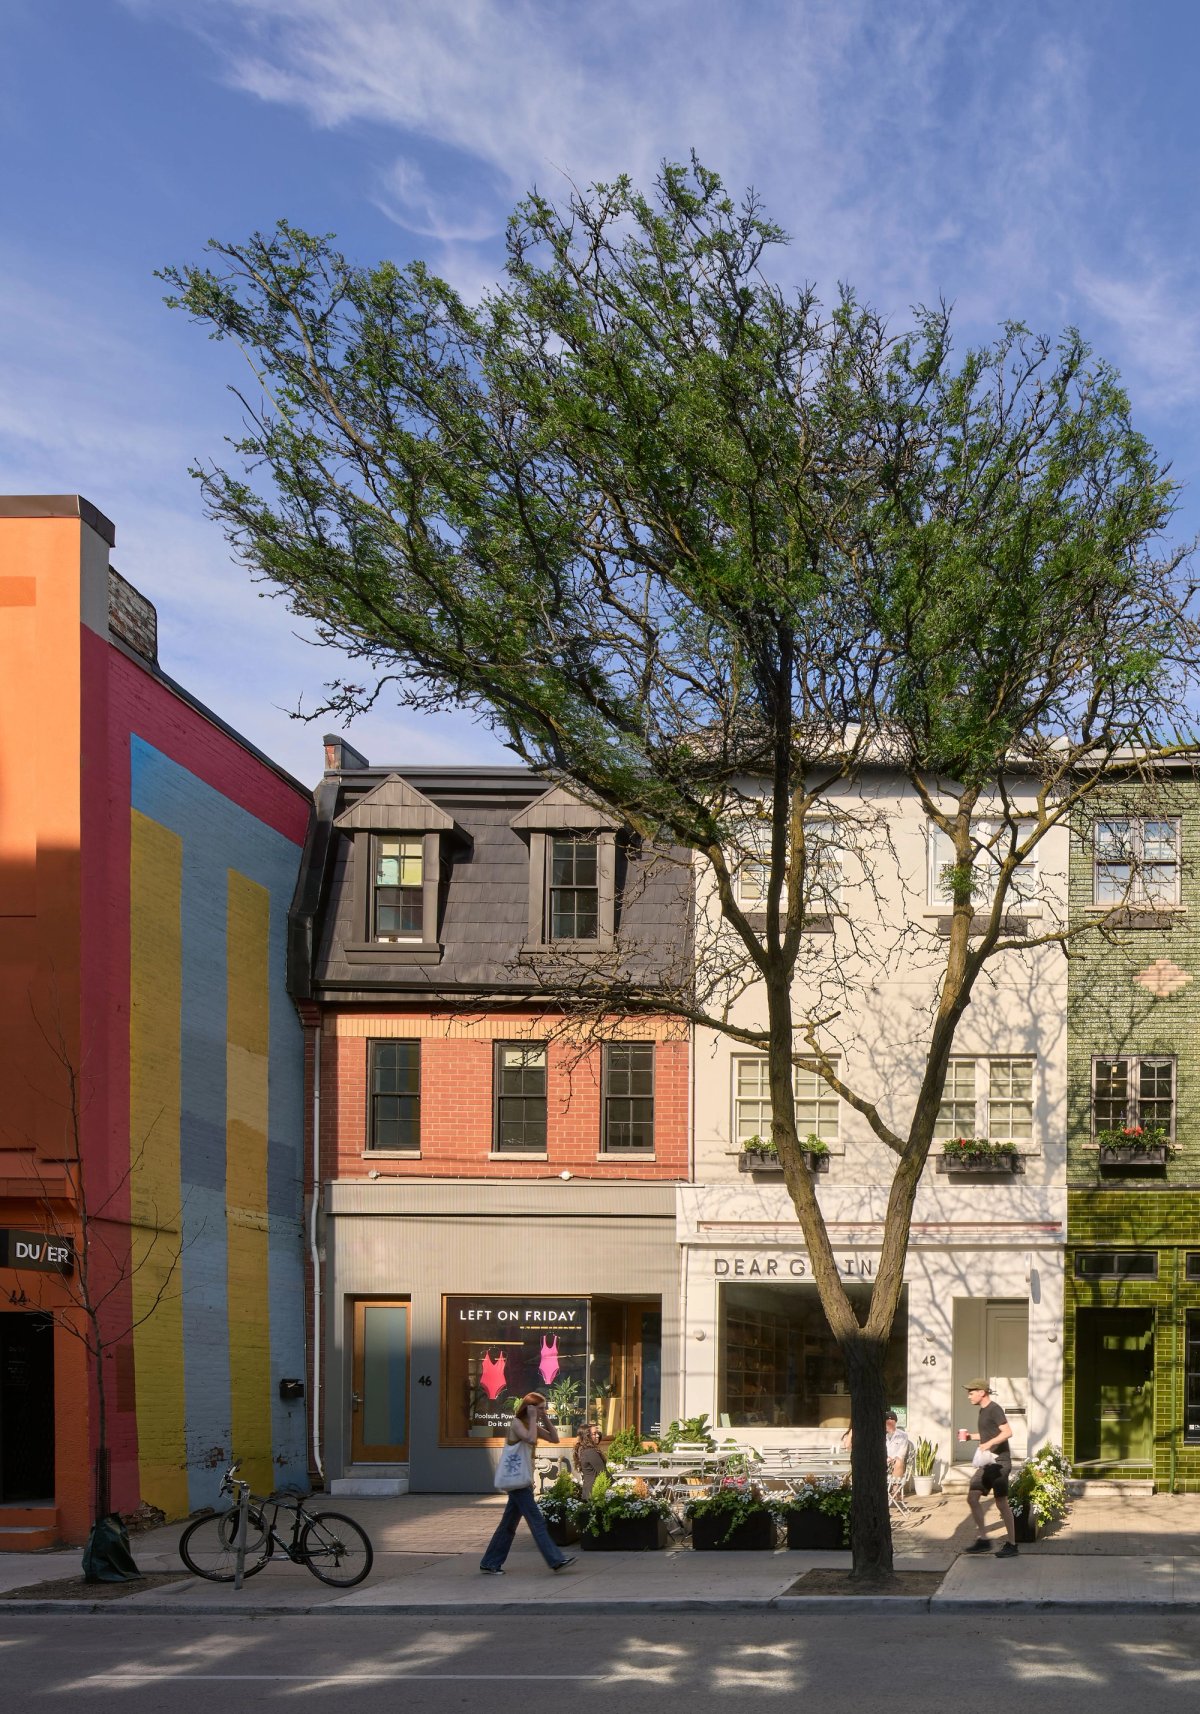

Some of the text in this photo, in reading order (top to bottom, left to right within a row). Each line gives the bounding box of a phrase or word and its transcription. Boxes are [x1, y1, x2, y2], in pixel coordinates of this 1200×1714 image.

[15, 1242, 69, 1263] DU/ER
[714, 1258, 873, 1276] DEAR GIN
[8, 1290, 28, 1306] 44
[460, 1310, 576, 1322] LEFT ON FRIDAY
[921, 1355, 937, 1366] 48
[418, 1375, 433, 1387] 46
